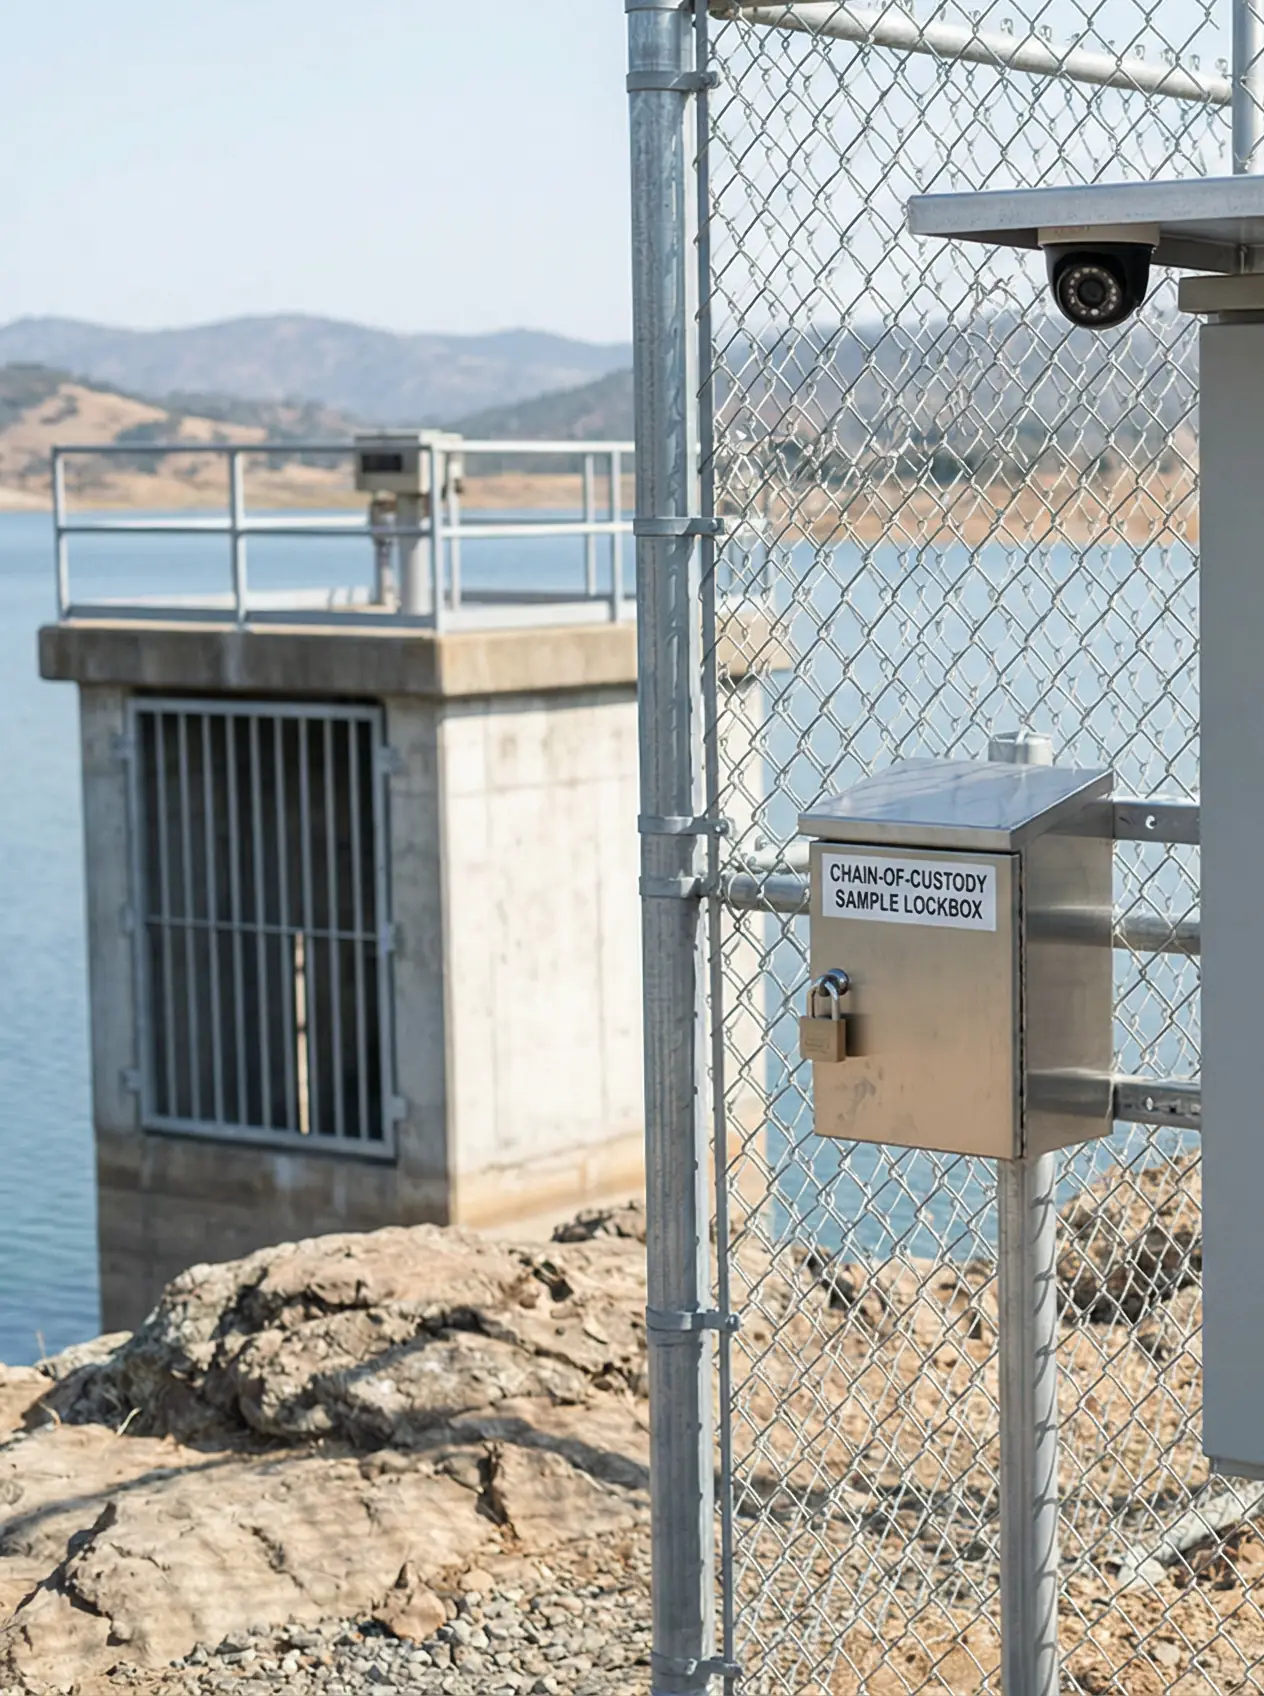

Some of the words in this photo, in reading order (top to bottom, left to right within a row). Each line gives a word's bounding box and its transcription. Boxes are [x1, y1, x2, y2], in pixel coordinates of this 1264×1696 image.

[830, 863, 987, 893] CHAIN-OF-CUSTODY
[835, 888, 899, 912] SAMPLE
[904, 894, 983, 919] LOCKBOX
